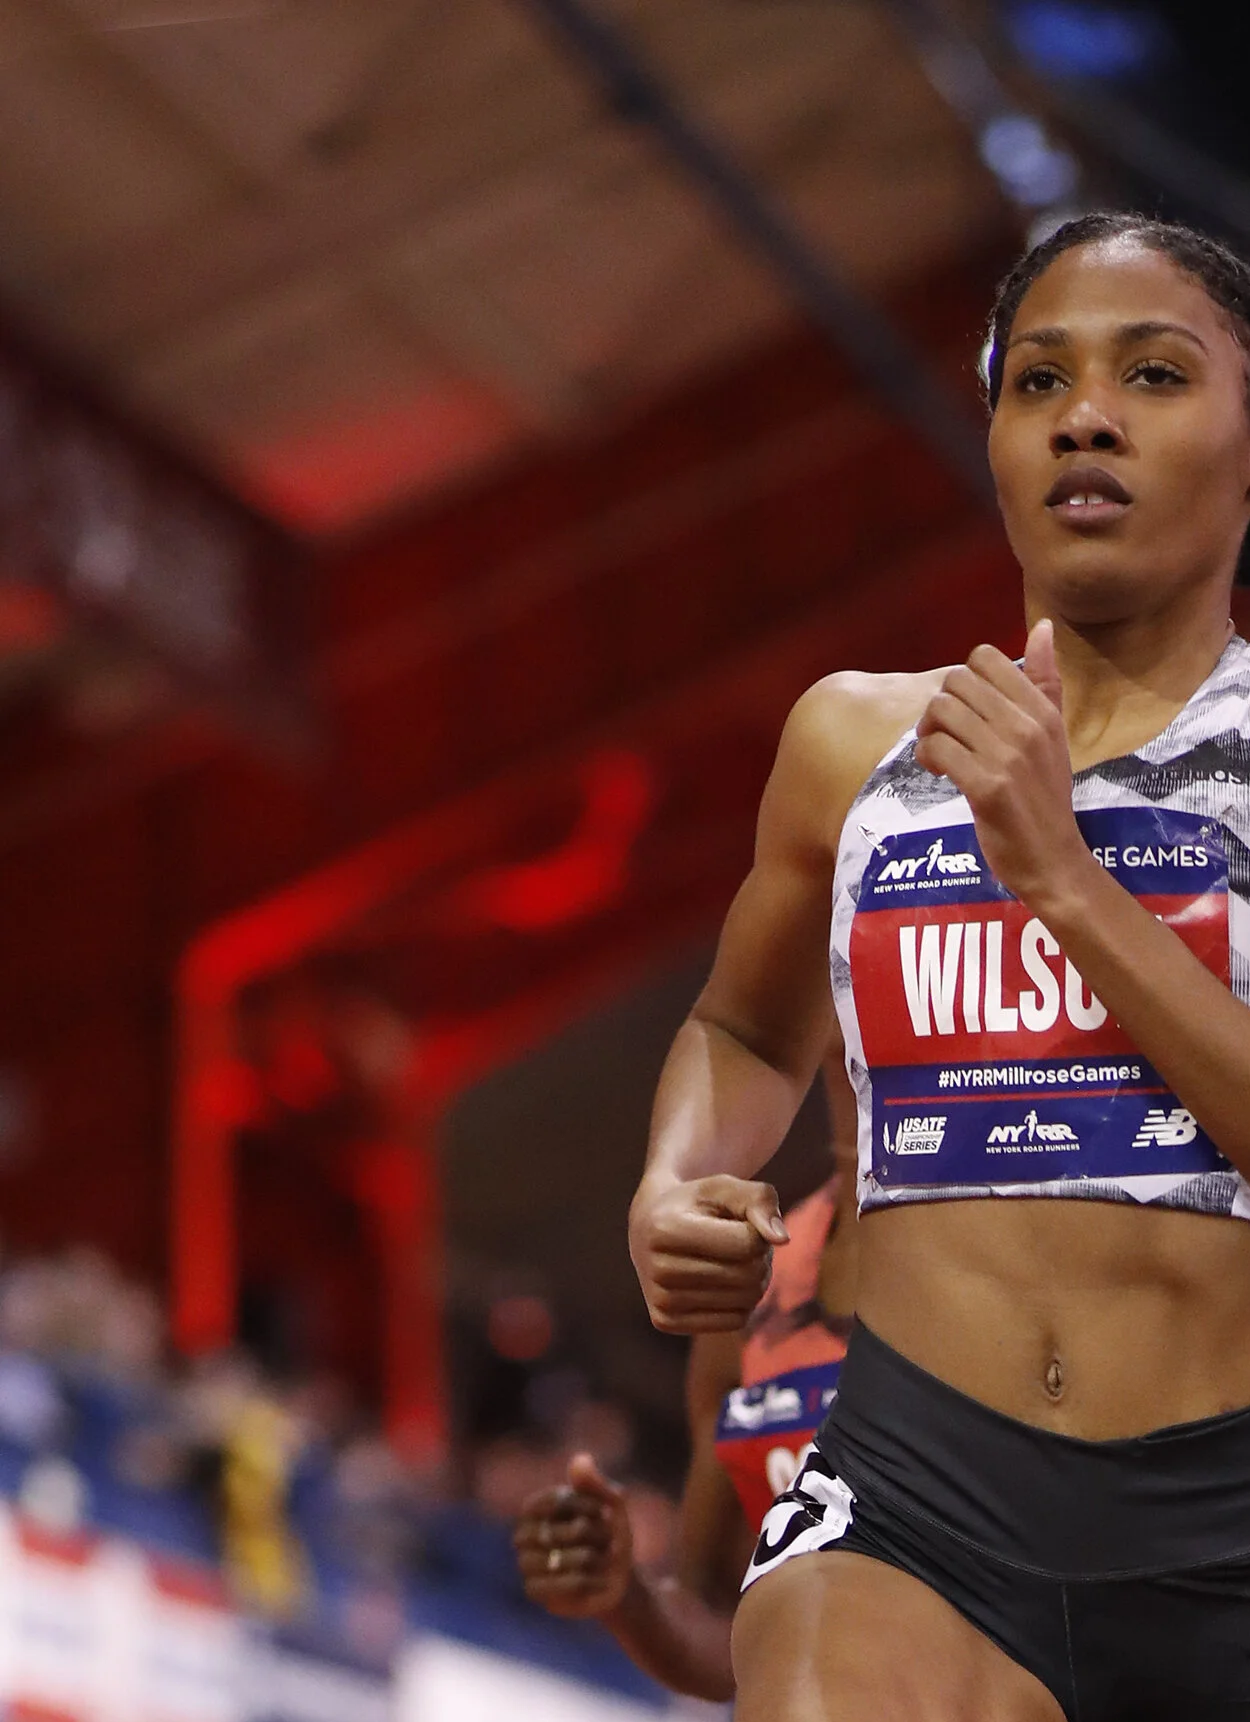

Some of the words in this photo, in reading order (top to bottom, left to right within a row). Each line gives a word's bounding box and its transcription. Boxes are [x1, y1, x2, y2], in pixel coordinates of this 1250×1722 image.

[1122, 845, 1209, 868] GAMES
[874, 884, 893, 895] NEW
[894, 882, 916, 892] YORK
[917, 879, 941, 890] ROAD
[942, 876, 982, 888] RUNNERS
[899, 917, 1109, 1037] WILSO
[938, 1063, 1142, 1089] #NYRRMillroseGames
[903, 1116, 948, 1132] USATF
[903, 1140, 938, 1152] SERIES
[986, 1146, 1002, 1155] NEW
[1003, 1145, 1022, 1154] YORK
[1023, 1144, 1044, 1153] ROAD
[1045, 1142, 1081, 1152] RUNNERS
